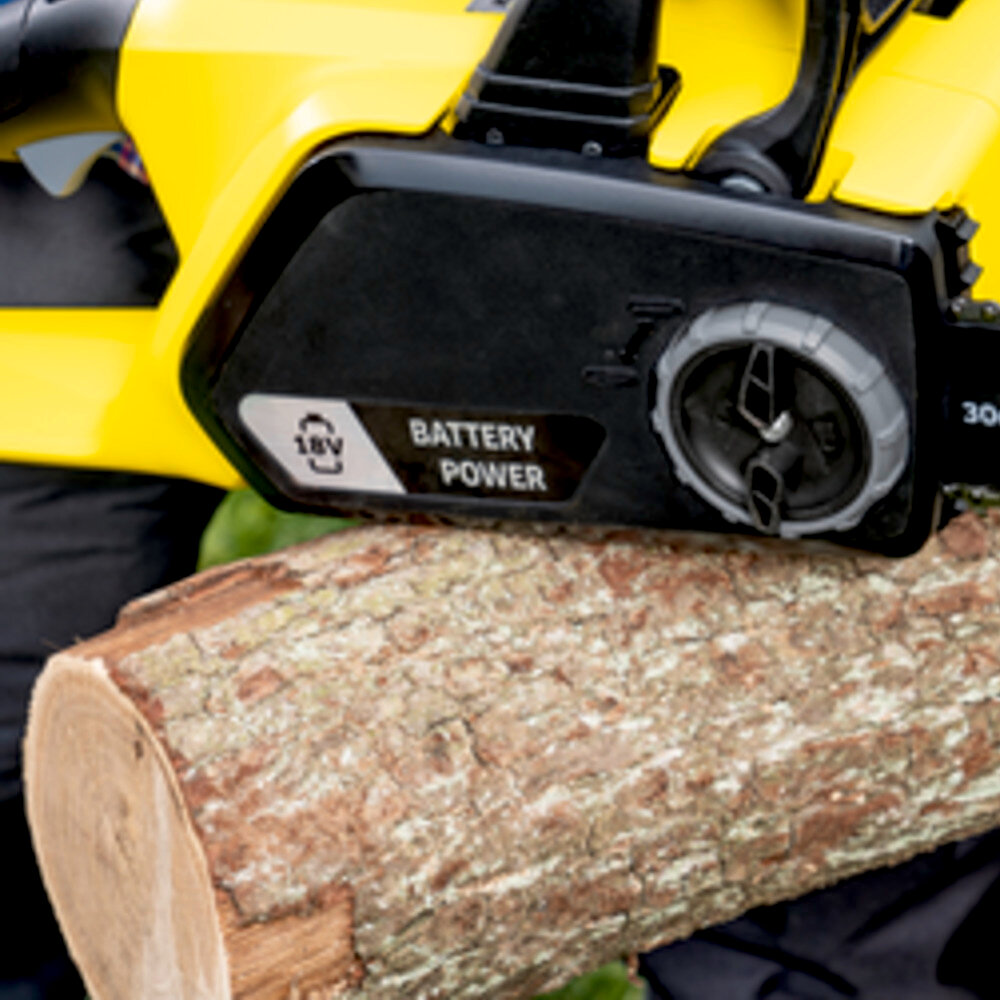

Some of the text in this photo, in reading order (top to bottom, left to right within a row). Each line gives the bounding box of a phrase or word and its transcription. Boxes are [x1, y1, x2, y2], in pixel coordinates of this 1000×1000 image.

[294, 436, 344, 457] 18V
[409, 417, 535, 451] BATTERY
[440, 458, 548, 492] POWER
